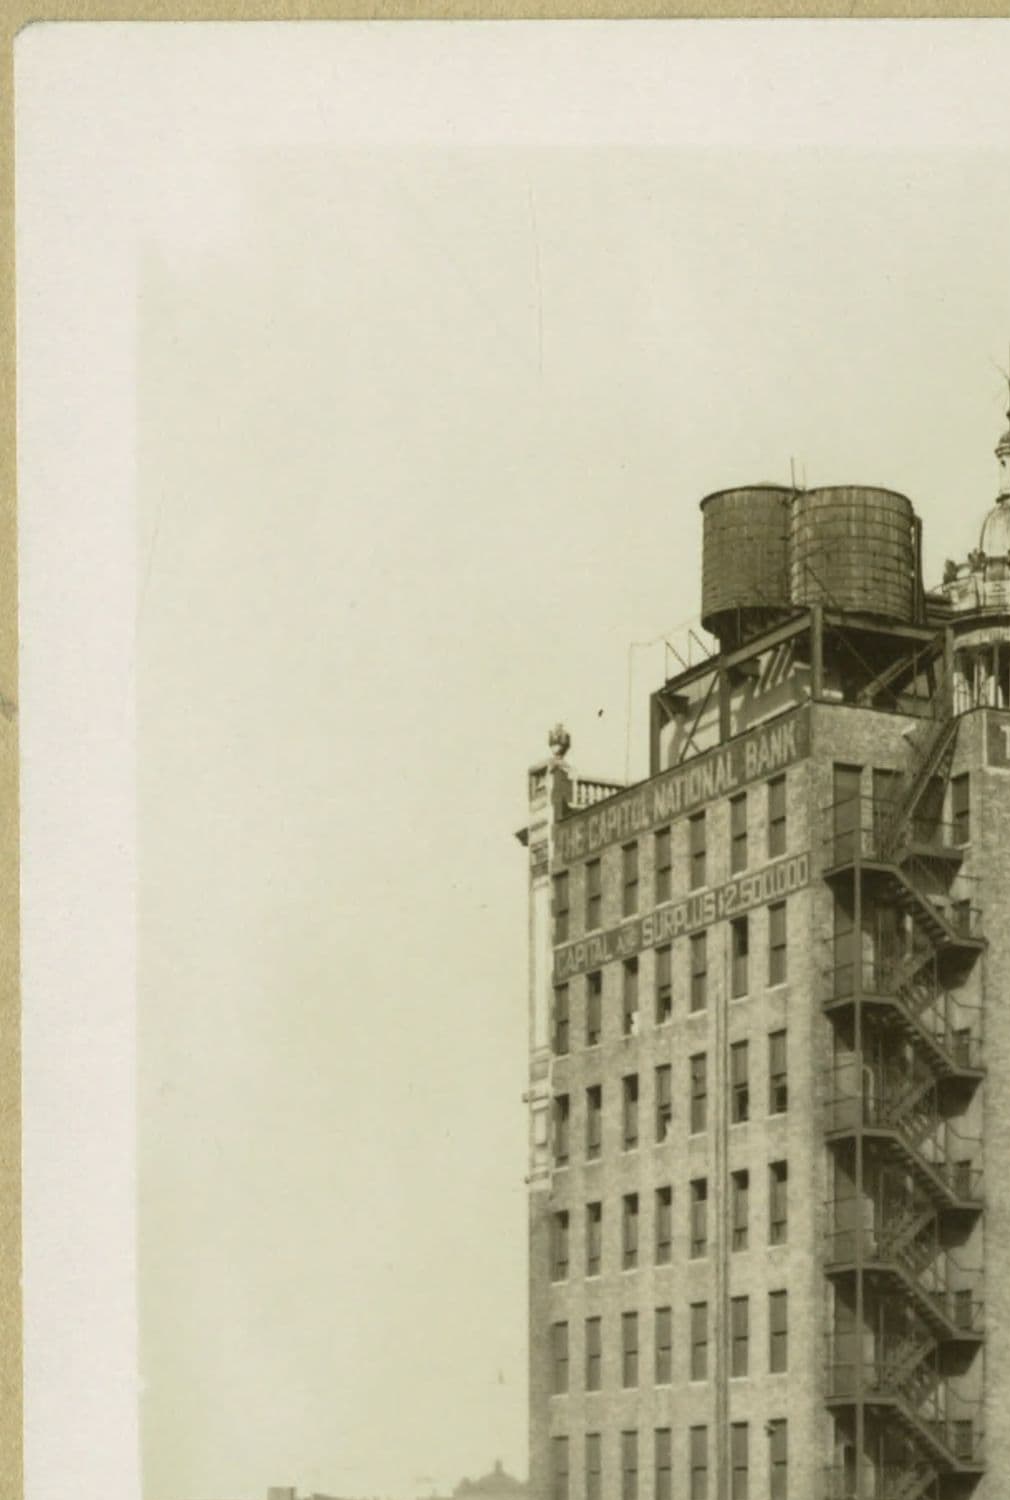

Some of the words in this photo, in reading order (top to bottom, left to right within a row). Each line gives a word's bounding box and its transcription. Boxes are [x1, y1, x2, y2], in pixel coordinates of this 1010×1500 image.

[652, 752, 738, 818] NATIONAL
[746, 720, 797, 779] BANK
[642, 891, 716, 946] SURPLUS
